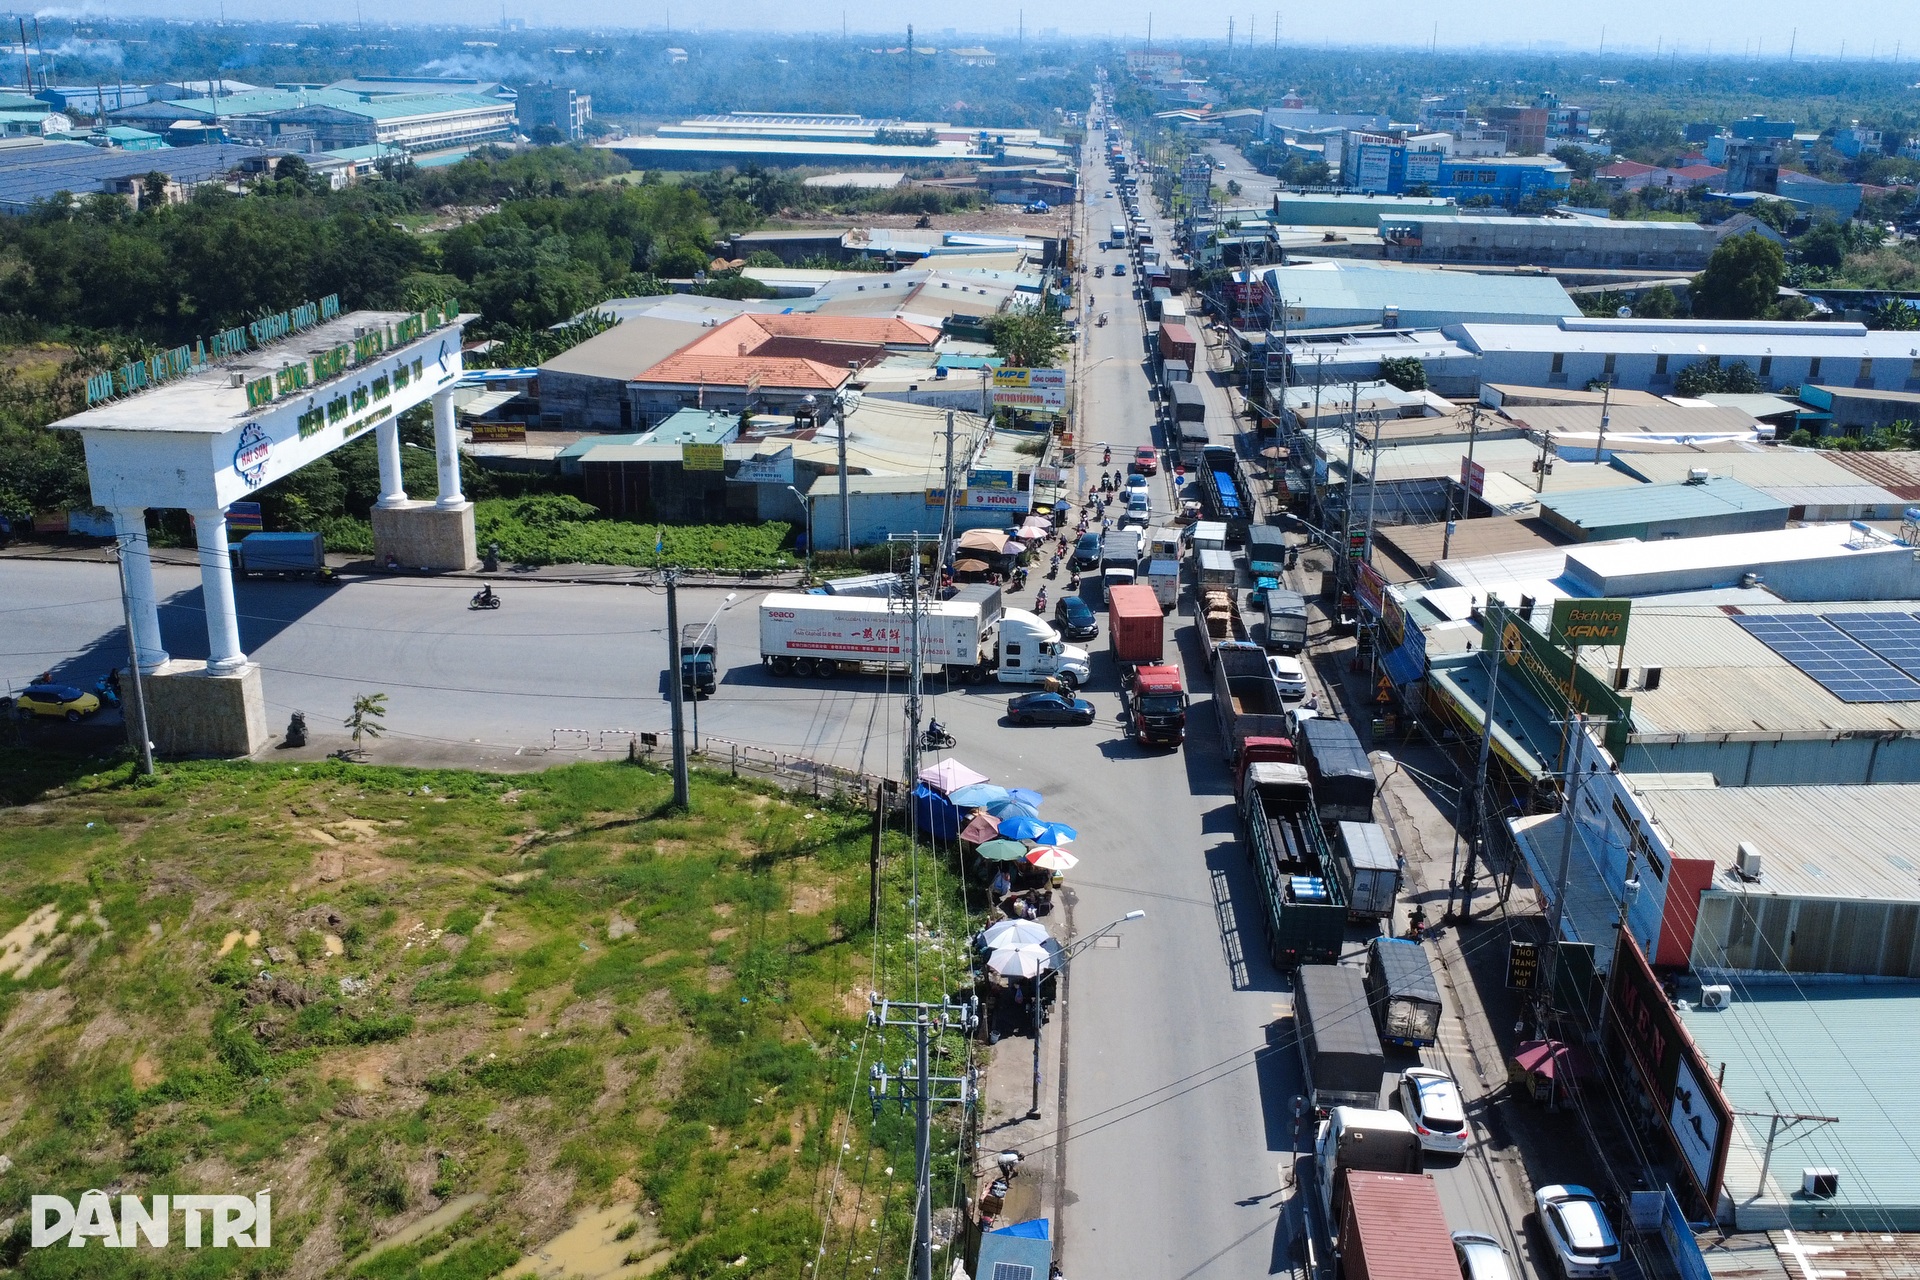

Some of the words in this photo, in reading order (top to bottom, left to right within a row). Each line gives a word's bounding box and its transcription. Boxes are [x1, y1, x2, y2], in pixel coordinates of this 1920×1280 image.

[996, 370, 1027, 379] MPE
[245, 375, 274, 409] KHU
[350, 381, 369, 415] CÁC
[987, 495, 1017, 504] HÙNG
[1569, 609, 1599, 621] Bách
[1601, 610, 1622, 621] hóa
[1564, 625, 1619, 637] XANH
[1511, 958, 1537, 968] TRANG
[1513, 969, 1531, 977] NAM
